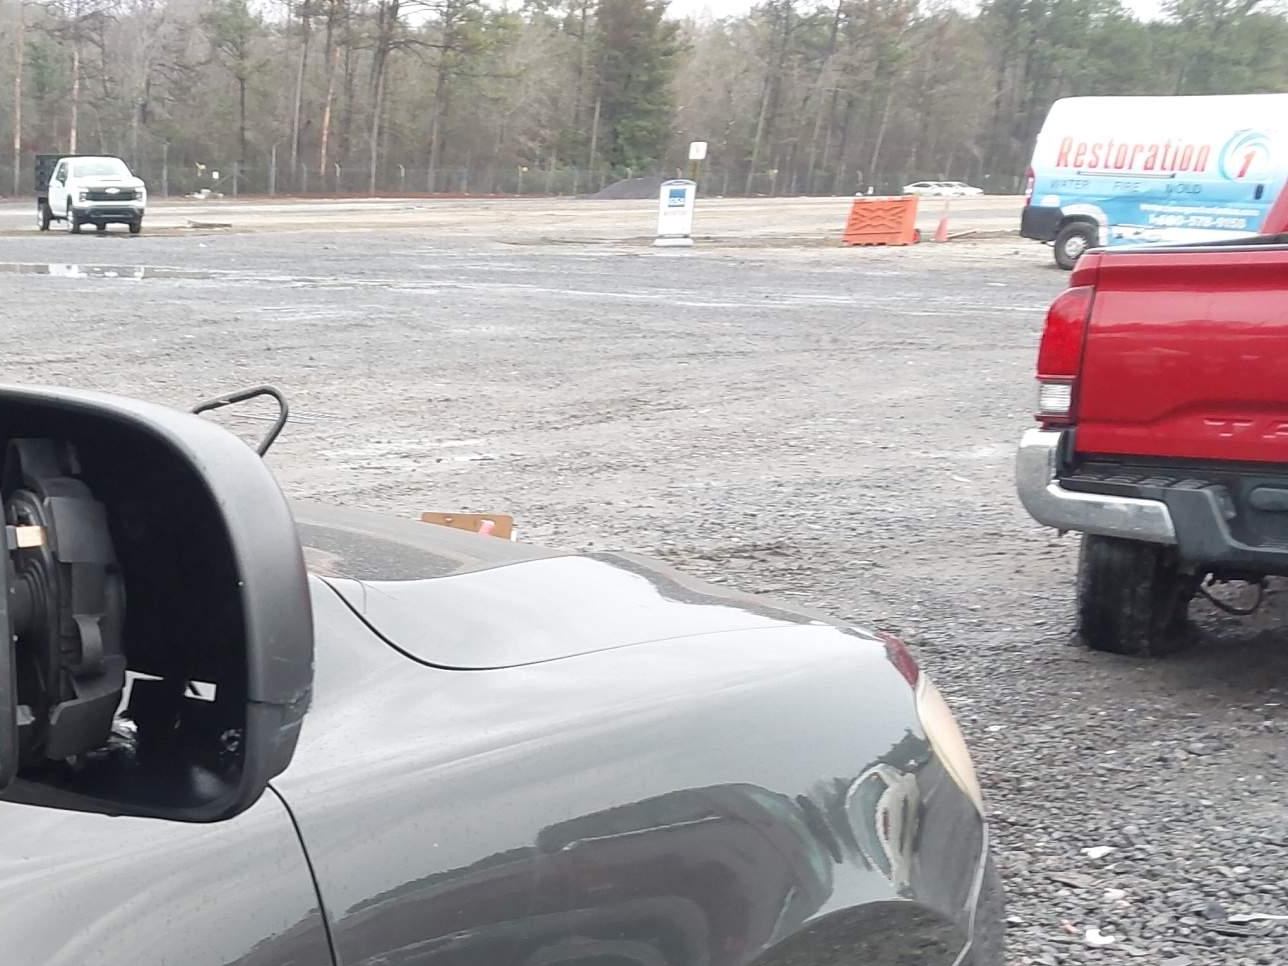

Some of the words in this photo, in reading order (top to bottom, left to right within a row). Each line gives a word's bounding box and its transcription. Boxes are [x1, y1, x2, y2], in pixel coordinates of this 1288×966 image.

[1055, 136, 1211, 173] Restoration
[1237, 150, 1256, 179] 1
[1049, 178, 1090, 190] WATER
[1114, 181, 1142, 193] FIRE
[1165, 183, 1202, 195] MOLD
